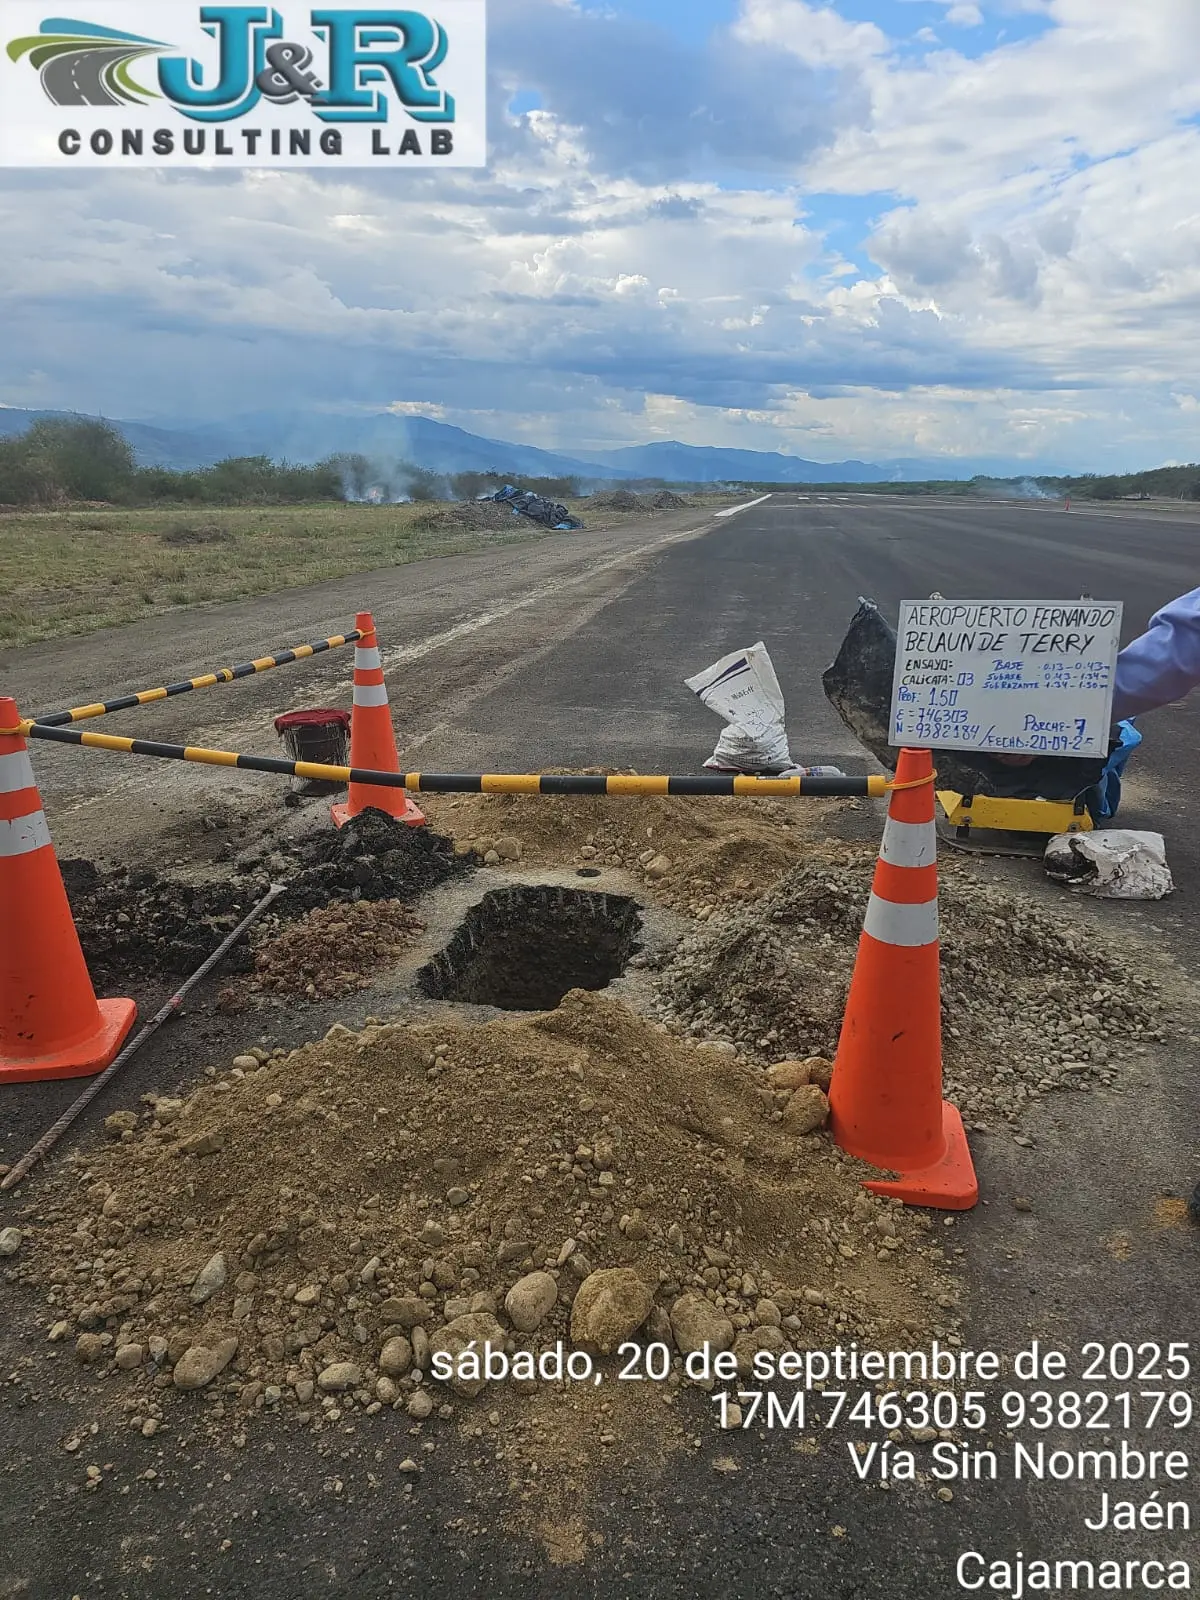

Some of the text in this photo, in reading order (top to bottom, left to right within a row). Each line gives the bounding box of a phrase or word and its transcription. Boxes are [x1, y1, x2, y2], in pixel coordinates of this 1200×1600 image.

[907, 606, 1115, 630] AEROPUERTO FERNANDO
[1019, 633, 1096, 655] TERRY
[905, 659, 953, 671] ENSAYO:
[992, 659, 1024, 671] BASE
[957, 672, 974, 687] 03
[929, 687, 958, 706] 1.50
